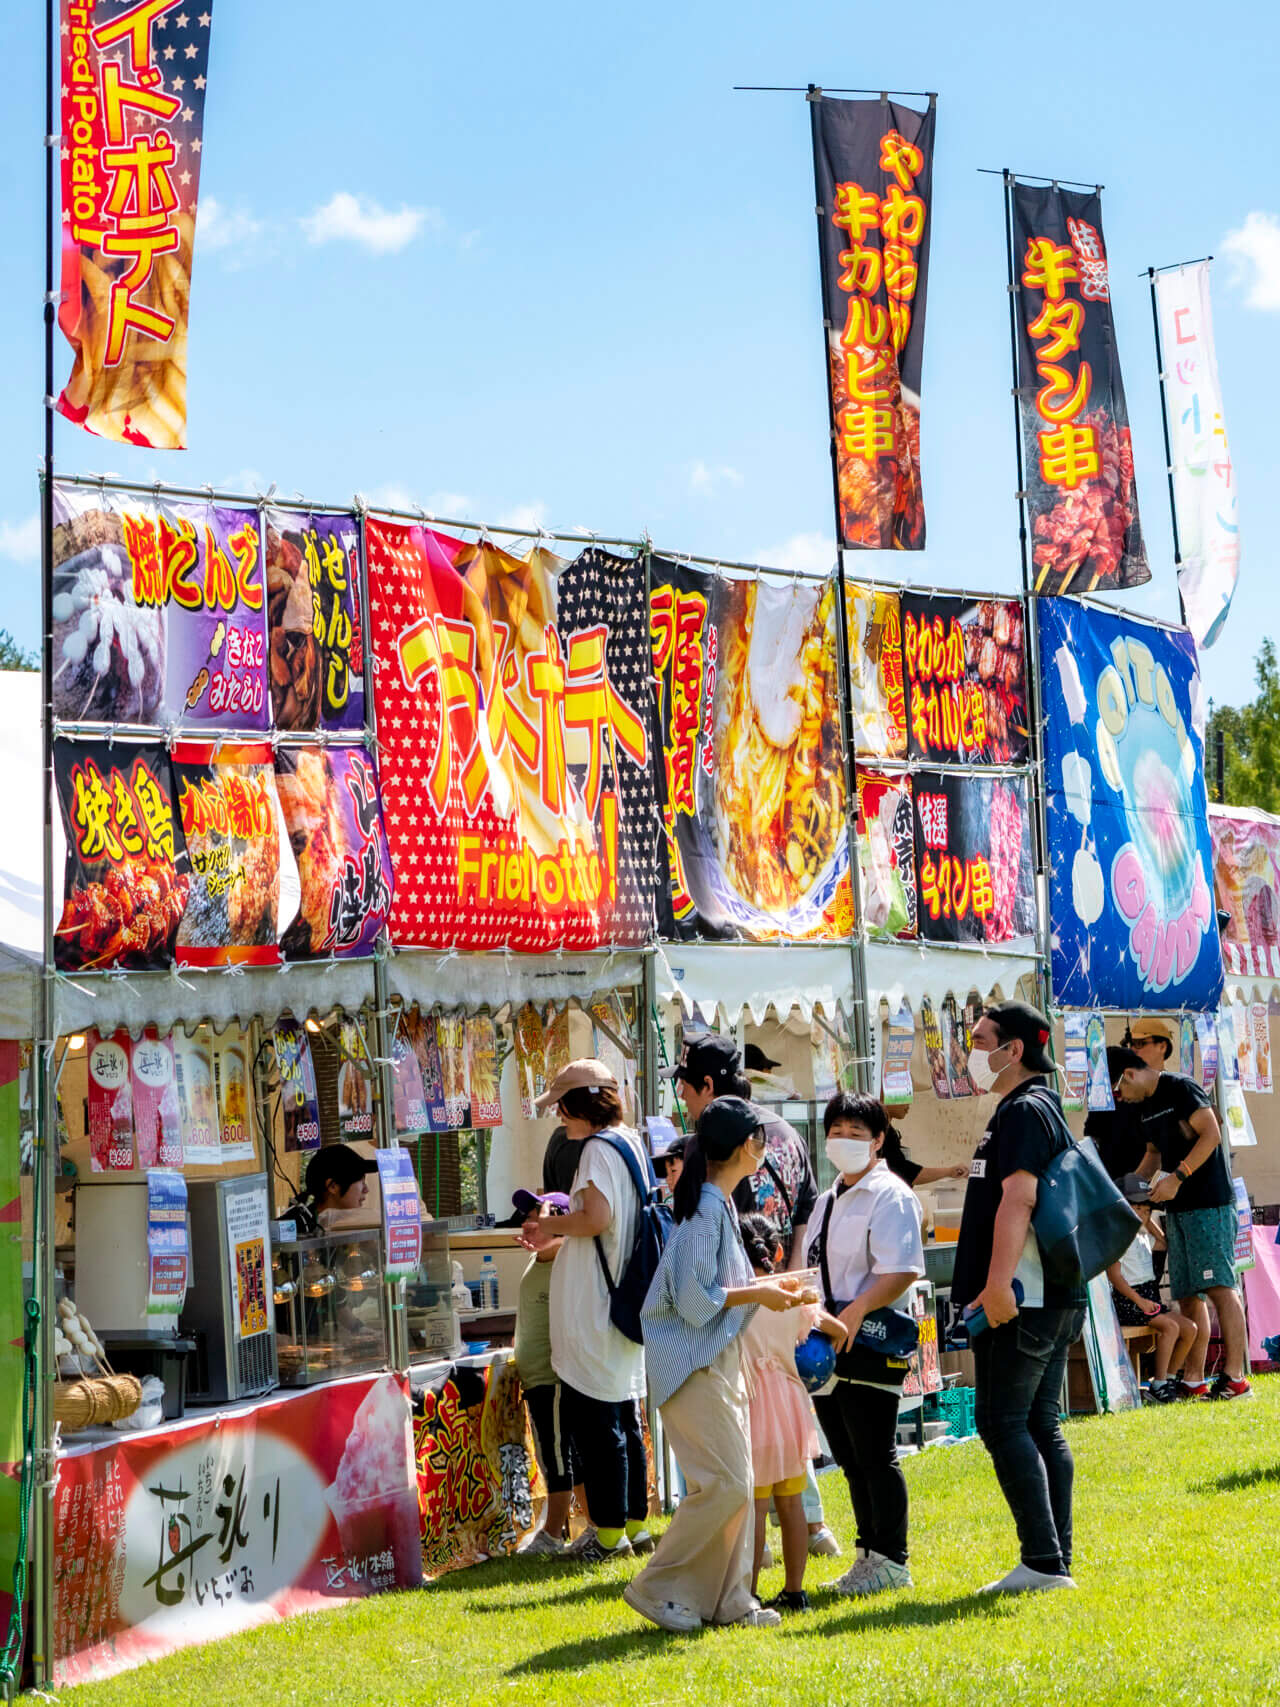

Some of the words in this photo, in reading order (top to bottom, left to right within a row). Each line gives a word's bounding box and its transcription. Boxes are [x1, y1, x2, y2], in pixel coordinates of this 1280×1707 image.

[833, 181, 897, 461] 牛カルビ串
[1020, 236, 1102, 490] 牛タン串
[904, 611, 966, 685] やわらか
[209, 671, 264, 714] みたらし
[72, 758, 178, 866] 焼き鳥
[179, 772, 274, 839] から揚げ
[917, 792, 948, 851] 特選
[223, 1123, 244, 1142] 600
[297, 1121, 319, 1142] ¥500
